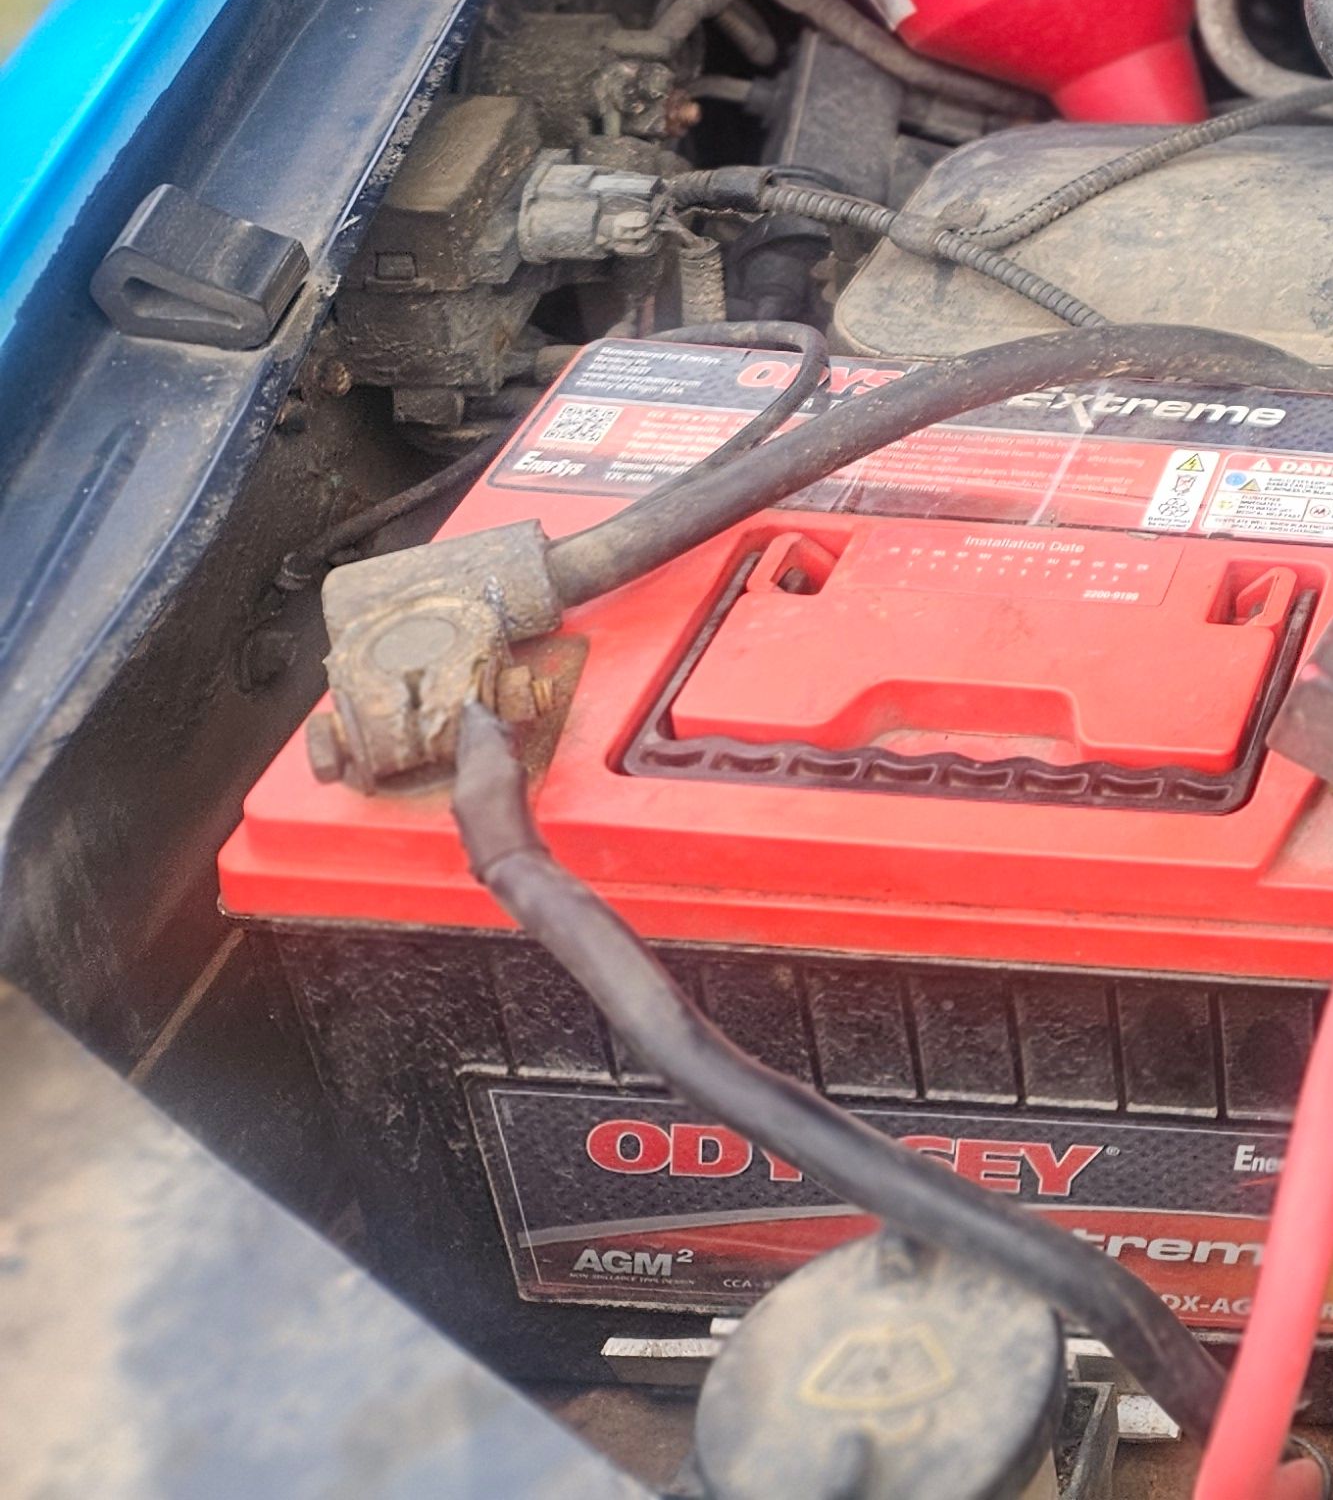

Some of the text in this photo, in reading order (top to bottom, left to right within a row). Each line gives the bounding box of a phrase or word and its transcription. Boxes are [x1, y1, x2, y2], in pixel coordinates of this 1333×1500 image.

[739, 361, 1287, 430] ODYS Extreme
[512, 450, 587, 477] EnerSys
[964, 534, 1085, 553] Installation Date
[586, 1118, 1107, 1197] ODSEY
